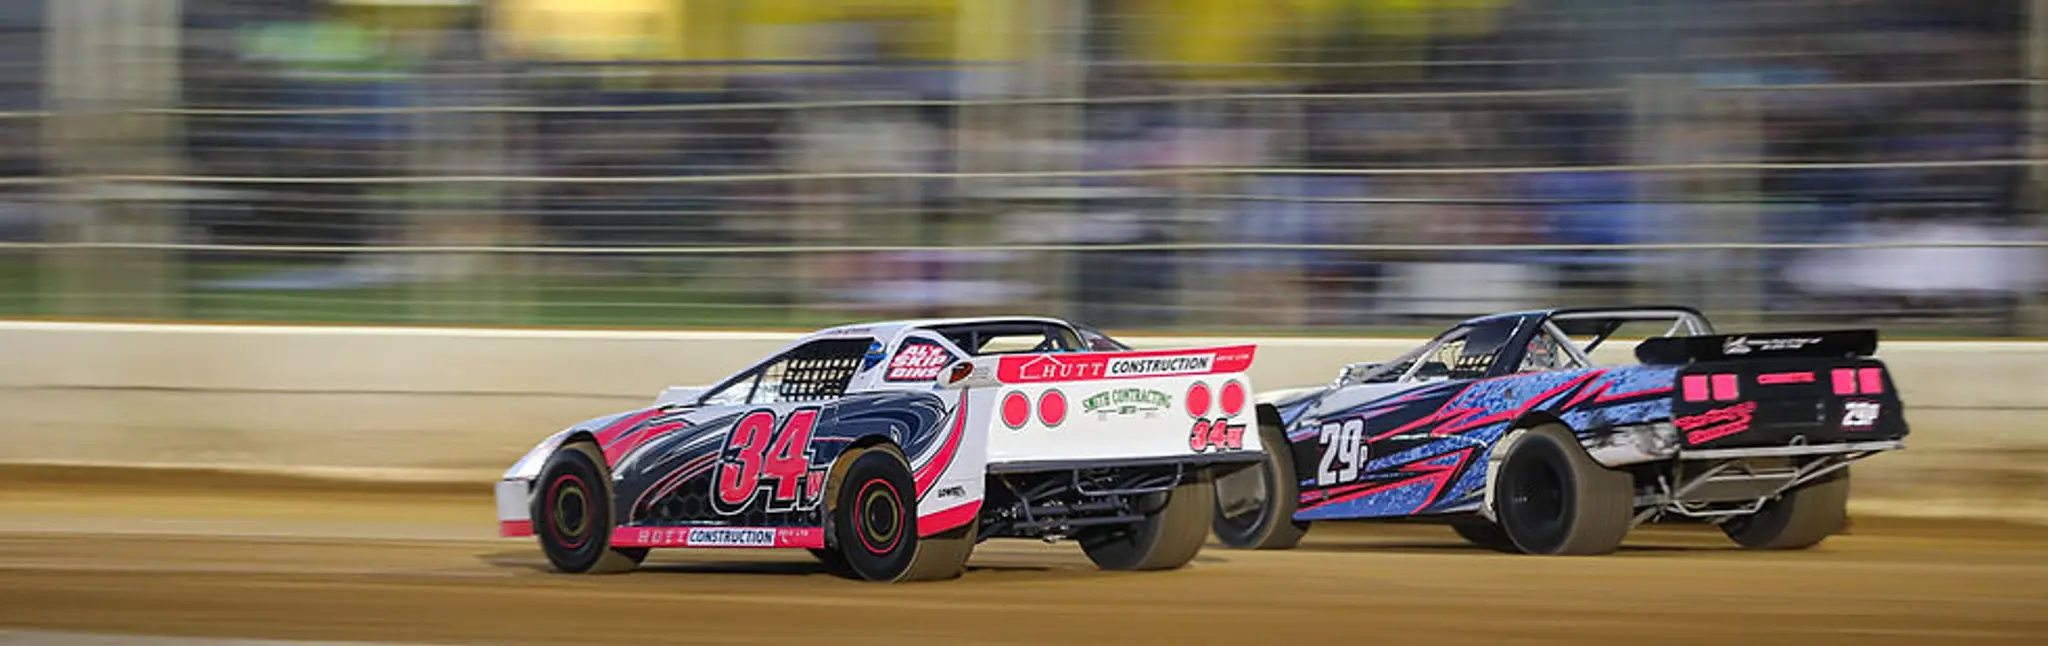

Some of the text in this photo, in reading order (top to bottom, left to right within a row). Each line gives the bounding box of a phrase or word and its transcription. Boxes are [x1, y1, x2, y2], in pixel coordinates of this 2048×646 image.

[893, 355, 947, 367] SKIP
[1043, 363, 1104, 378] HUTT
[1111, 357, 1208, 374] CONSTRUCTION
[890, 367, 939, 379] BINS
[1083, 388, 1172, 413] SMITH CONTRACTING
[637, 529, 687, 543] HUTT
[690, 530, 773, 543] CONSTRUCTION
